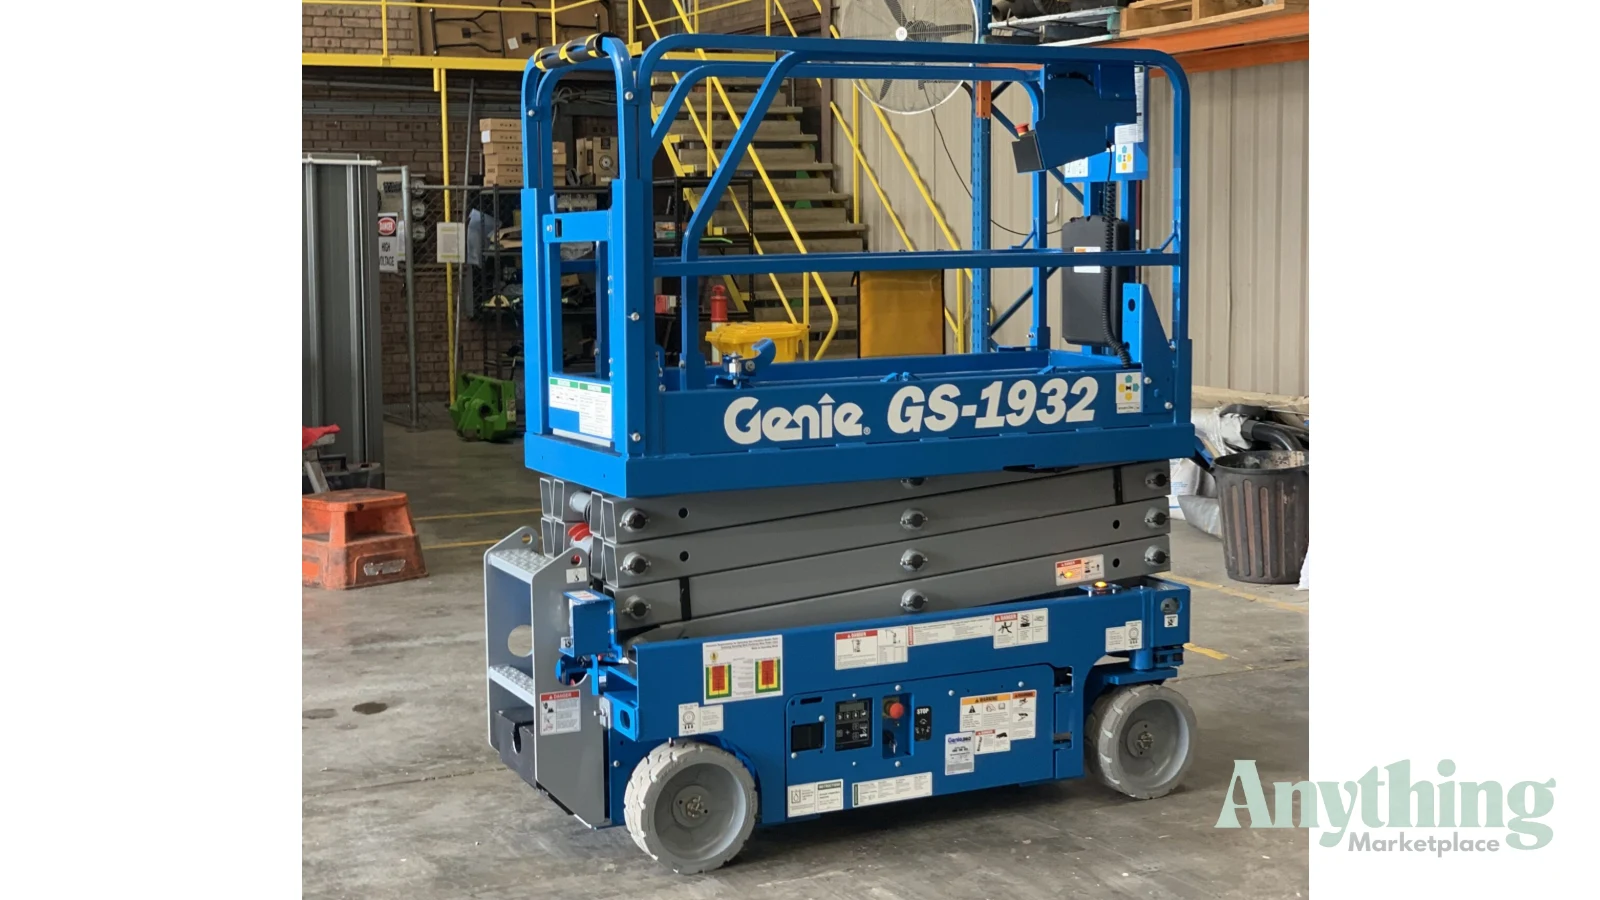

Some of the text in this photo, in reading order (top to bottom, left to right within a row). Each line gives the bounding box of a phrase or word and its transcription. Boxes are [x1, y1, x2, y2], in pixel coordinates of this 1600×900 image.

[381, 242, 391, 252] HIGH
[379, 256, 395, 266] OLTAGE
[723, 376, 1099, 445] Genie GS-1932
[916, 707, 930, 715] STOP
